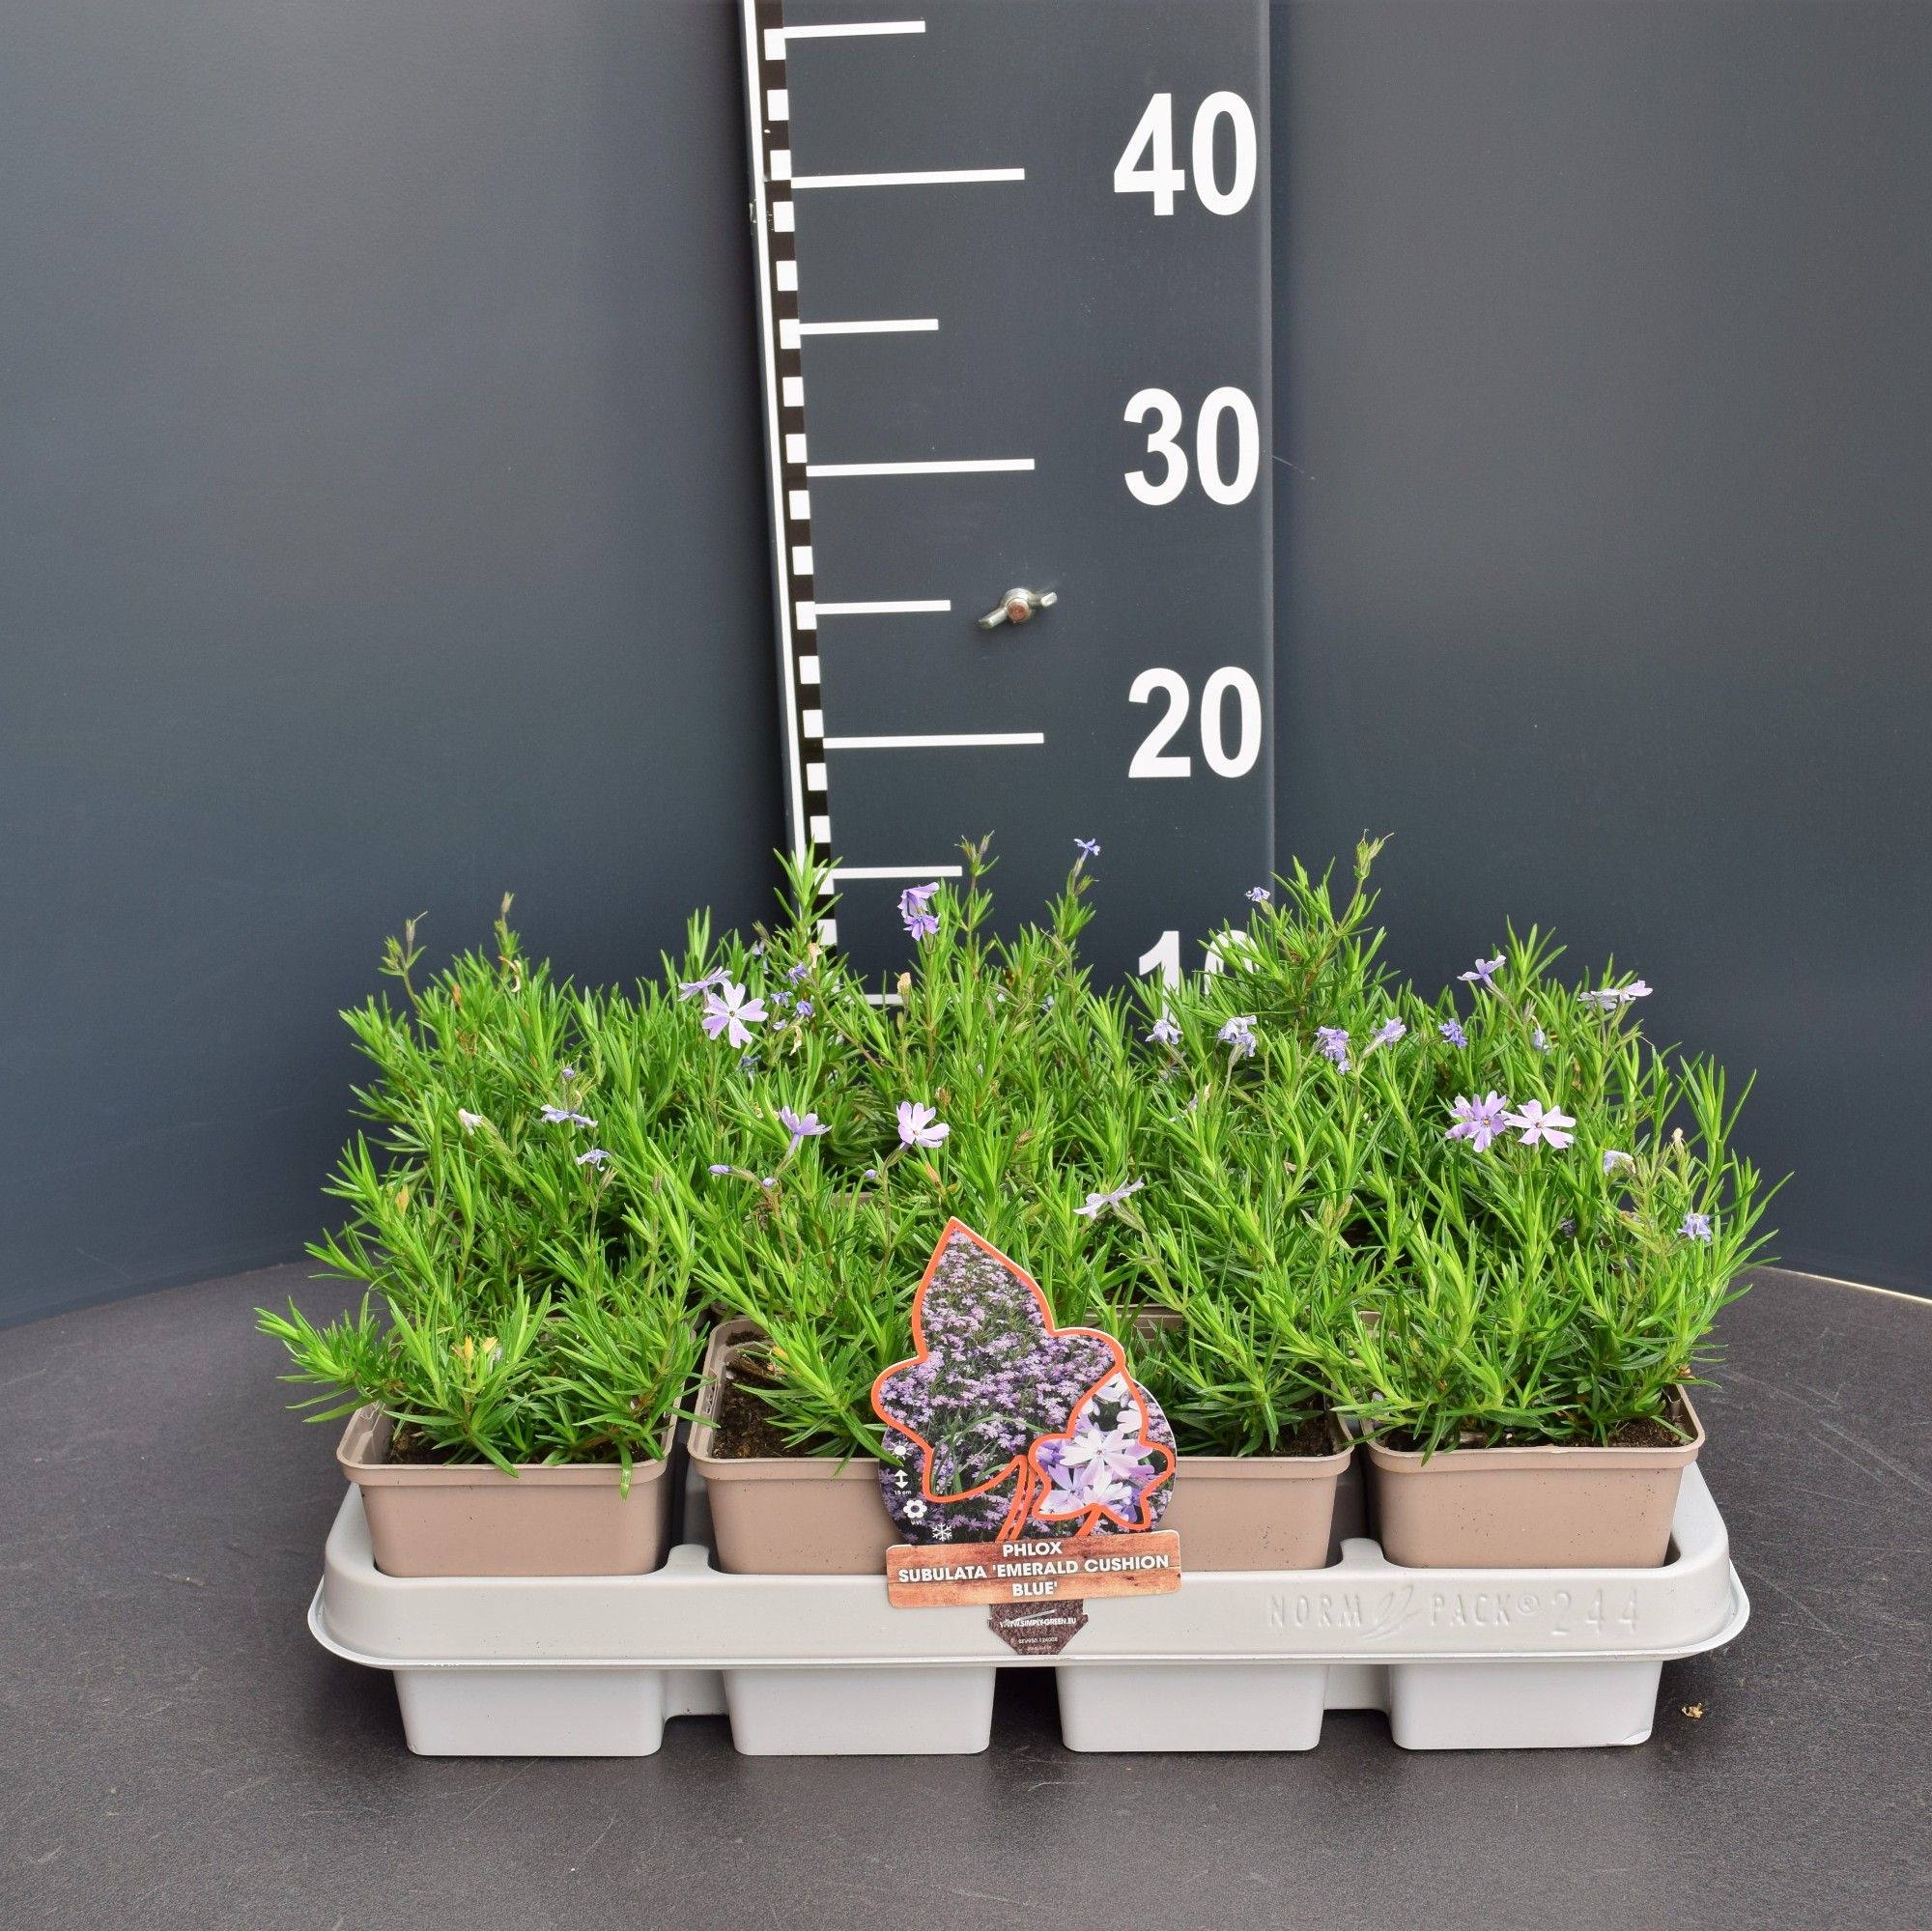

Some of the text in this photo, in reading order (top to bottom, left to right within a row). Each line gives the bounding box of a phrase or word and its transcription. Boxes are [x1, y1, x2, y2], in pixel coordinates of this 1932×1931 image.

[1114, 91, 1257, 216] 40
[1123, 386, 1260, 506] 30
[1128, 666, 1262, 779] 20
[898, 1554, 1170, 1583] SUBULATA 'EMERALD CUSHION
[1002, 1541, 1064, 1558] PHLOX
[1011, 1581, 1059, 1597] BLUE'
[1267, 1593, 1362, 1629] NORM
[1549, 1588, 1640, 1636] 244
